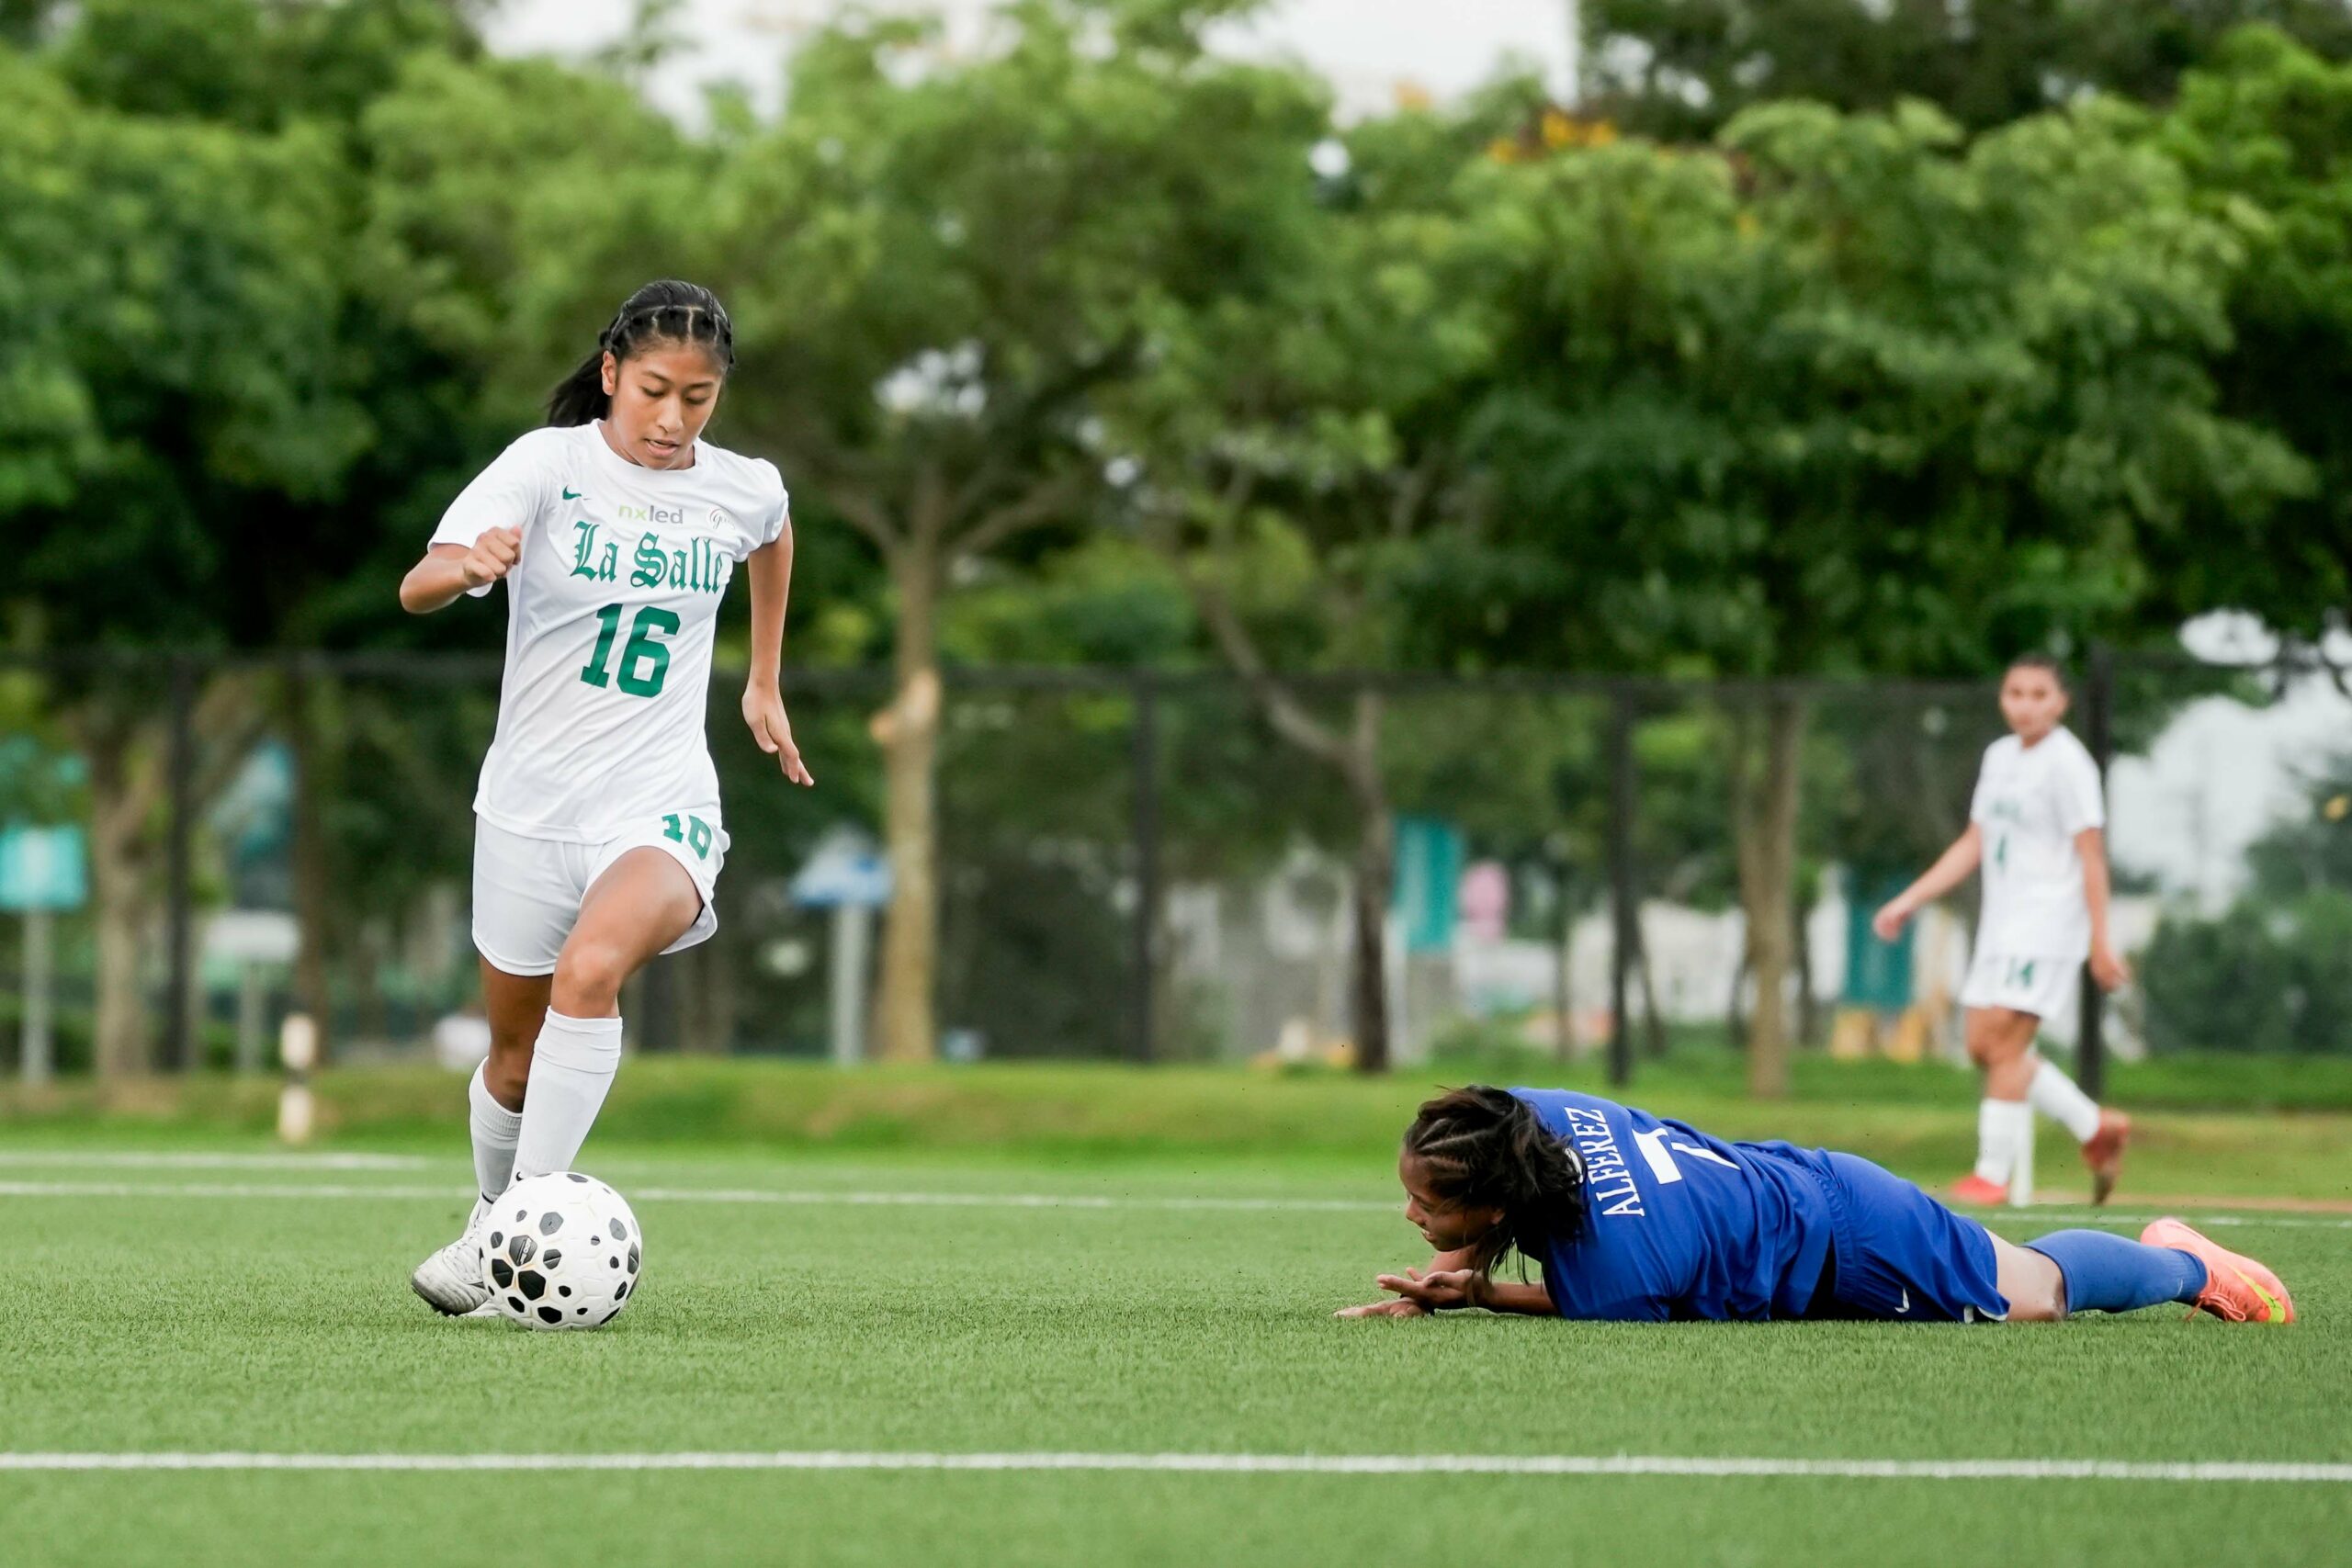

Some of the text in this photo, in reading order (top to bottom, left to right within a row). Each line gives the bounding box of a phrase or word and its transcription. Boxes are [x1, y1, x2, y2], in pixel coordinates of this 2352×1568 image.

[570, 521, 619, 582] La
[618, 505, 683, 524] nxled
[580, 603, 681, 698] 16
[1565, 1106, 1645, 1217] ALFEREZ
